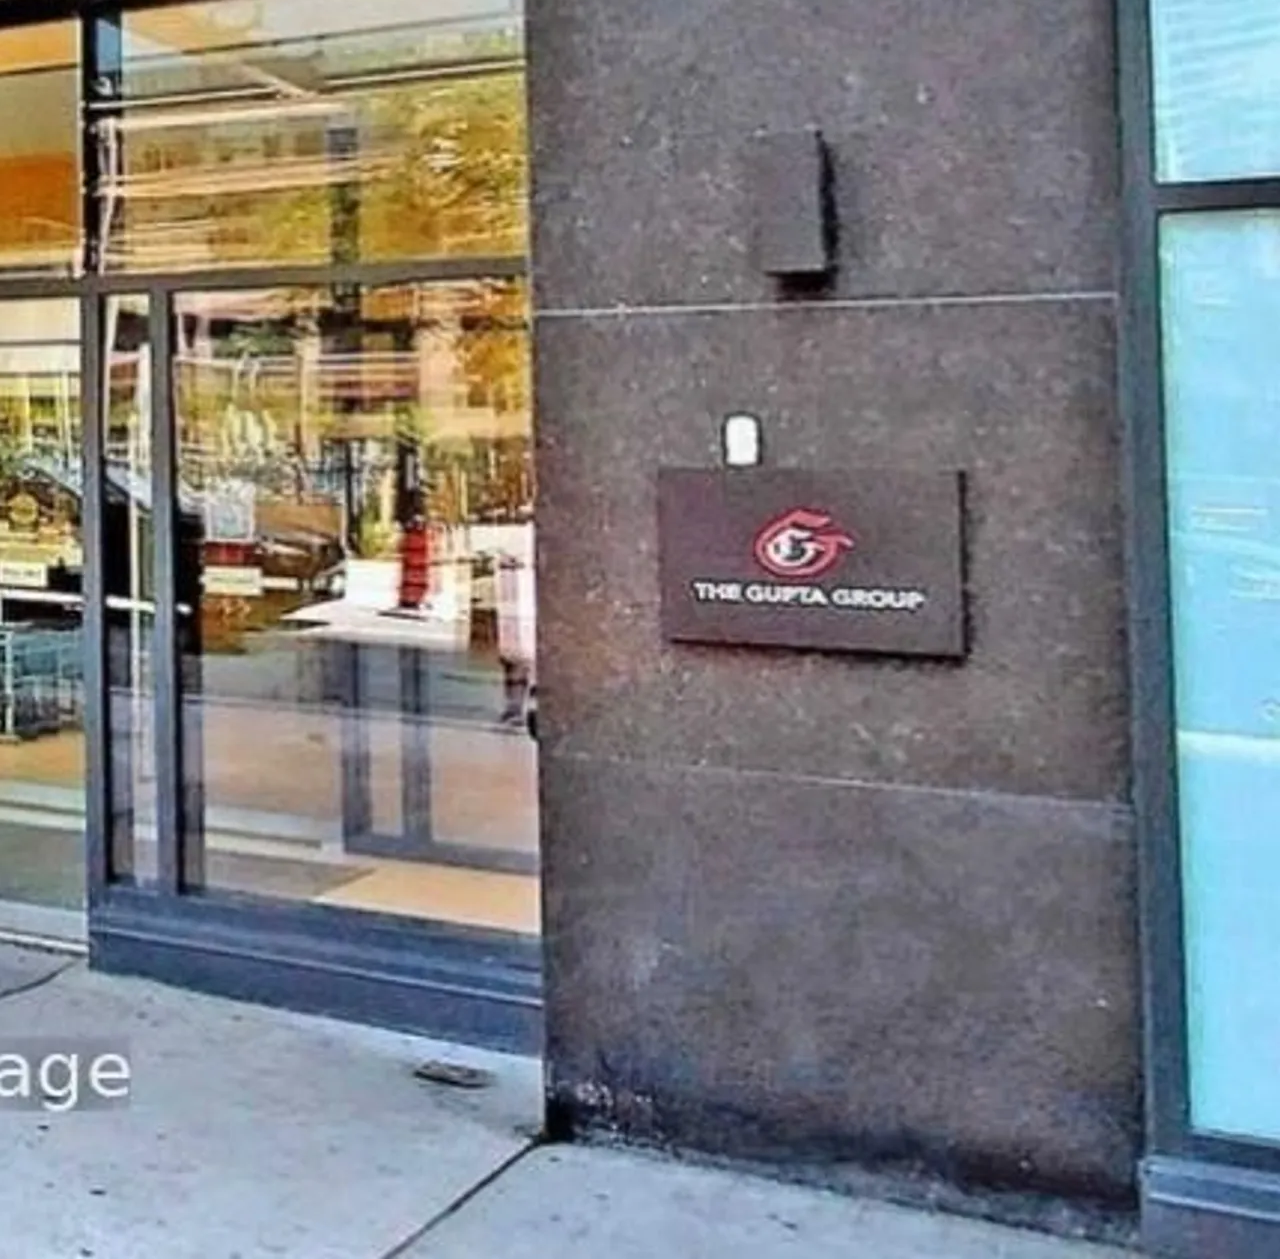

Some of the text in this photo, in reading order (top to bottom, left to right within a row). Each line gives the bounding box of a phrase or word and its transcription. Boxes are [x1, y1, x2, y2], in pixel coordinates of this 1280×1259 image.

[694, 582, 925, 610] THE GUPTA GROUP
